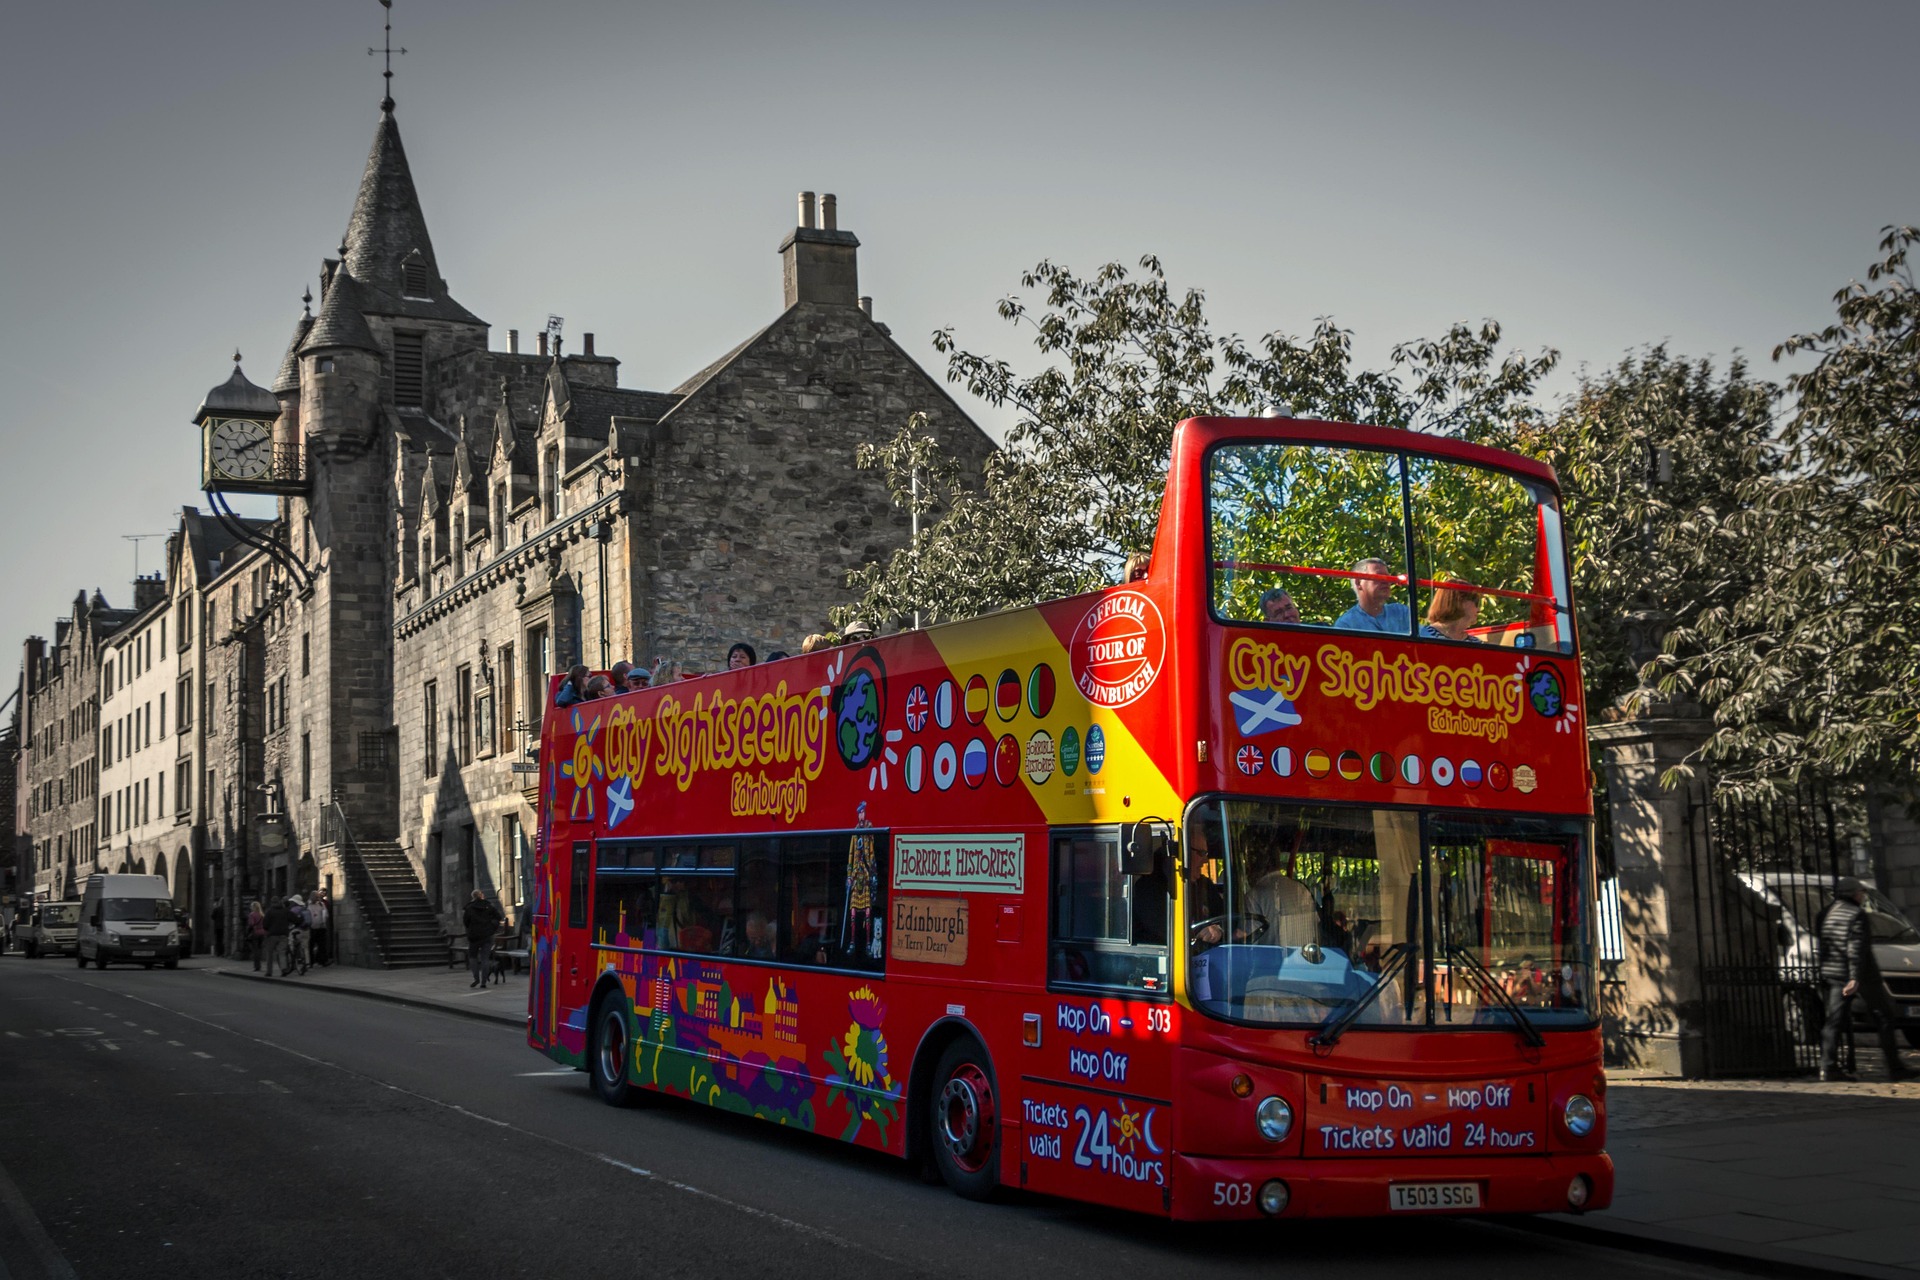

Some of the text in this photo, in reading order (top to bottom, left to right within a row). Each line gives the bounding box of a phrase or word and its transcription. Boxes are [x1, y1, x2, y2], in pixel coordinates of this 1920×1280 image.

[1087, 596, 1145, 631] OFFICIAL
[1087, 636, 1147, 663] TOUR OF
[1079, 661, 1155, 704] EDINBURGH
[1229, 637, 1525, 723] City Sightseeing
[605, 680, 828, 792] City Sightseeing
[1427, 706, 1508, 743] Edinburgh
[731, 767, 807, 825] Edinburgh
[900, 847, 1016, 880] HORRIBLE HISTORIES
[896, 903, 964, 943] Edinburgh
[905, 935, 924, 955] Terry
[926, 936, 949, 957] Deary
[1058, 1004, 1087, 1034] Hop
[1089, 1004, 1111, 1033] On
[1146, 1008, 1171, 1033] 503
[1070, 1050, 1128, 1081] Hop Off
[1346, 1087, 1384, 1111] Hop
[1387, 1085, 1412, 1108] On
[1447, 1086, 1481, 1111] Hop
[1485, 1084, 1512, 1107] Off
[1022, 1100, 1068, 1129] Tickets
[1029, 1134, 1061, 1159] valid
[1074, 1108, 1165, 1186] 24 hours
[1320, 1122, 1535, 1150] Tickets valid 24 hours
[1213, 1182, 1252, 1206] 503
[1395, 1183, 1473, 1208] T503 SSG
